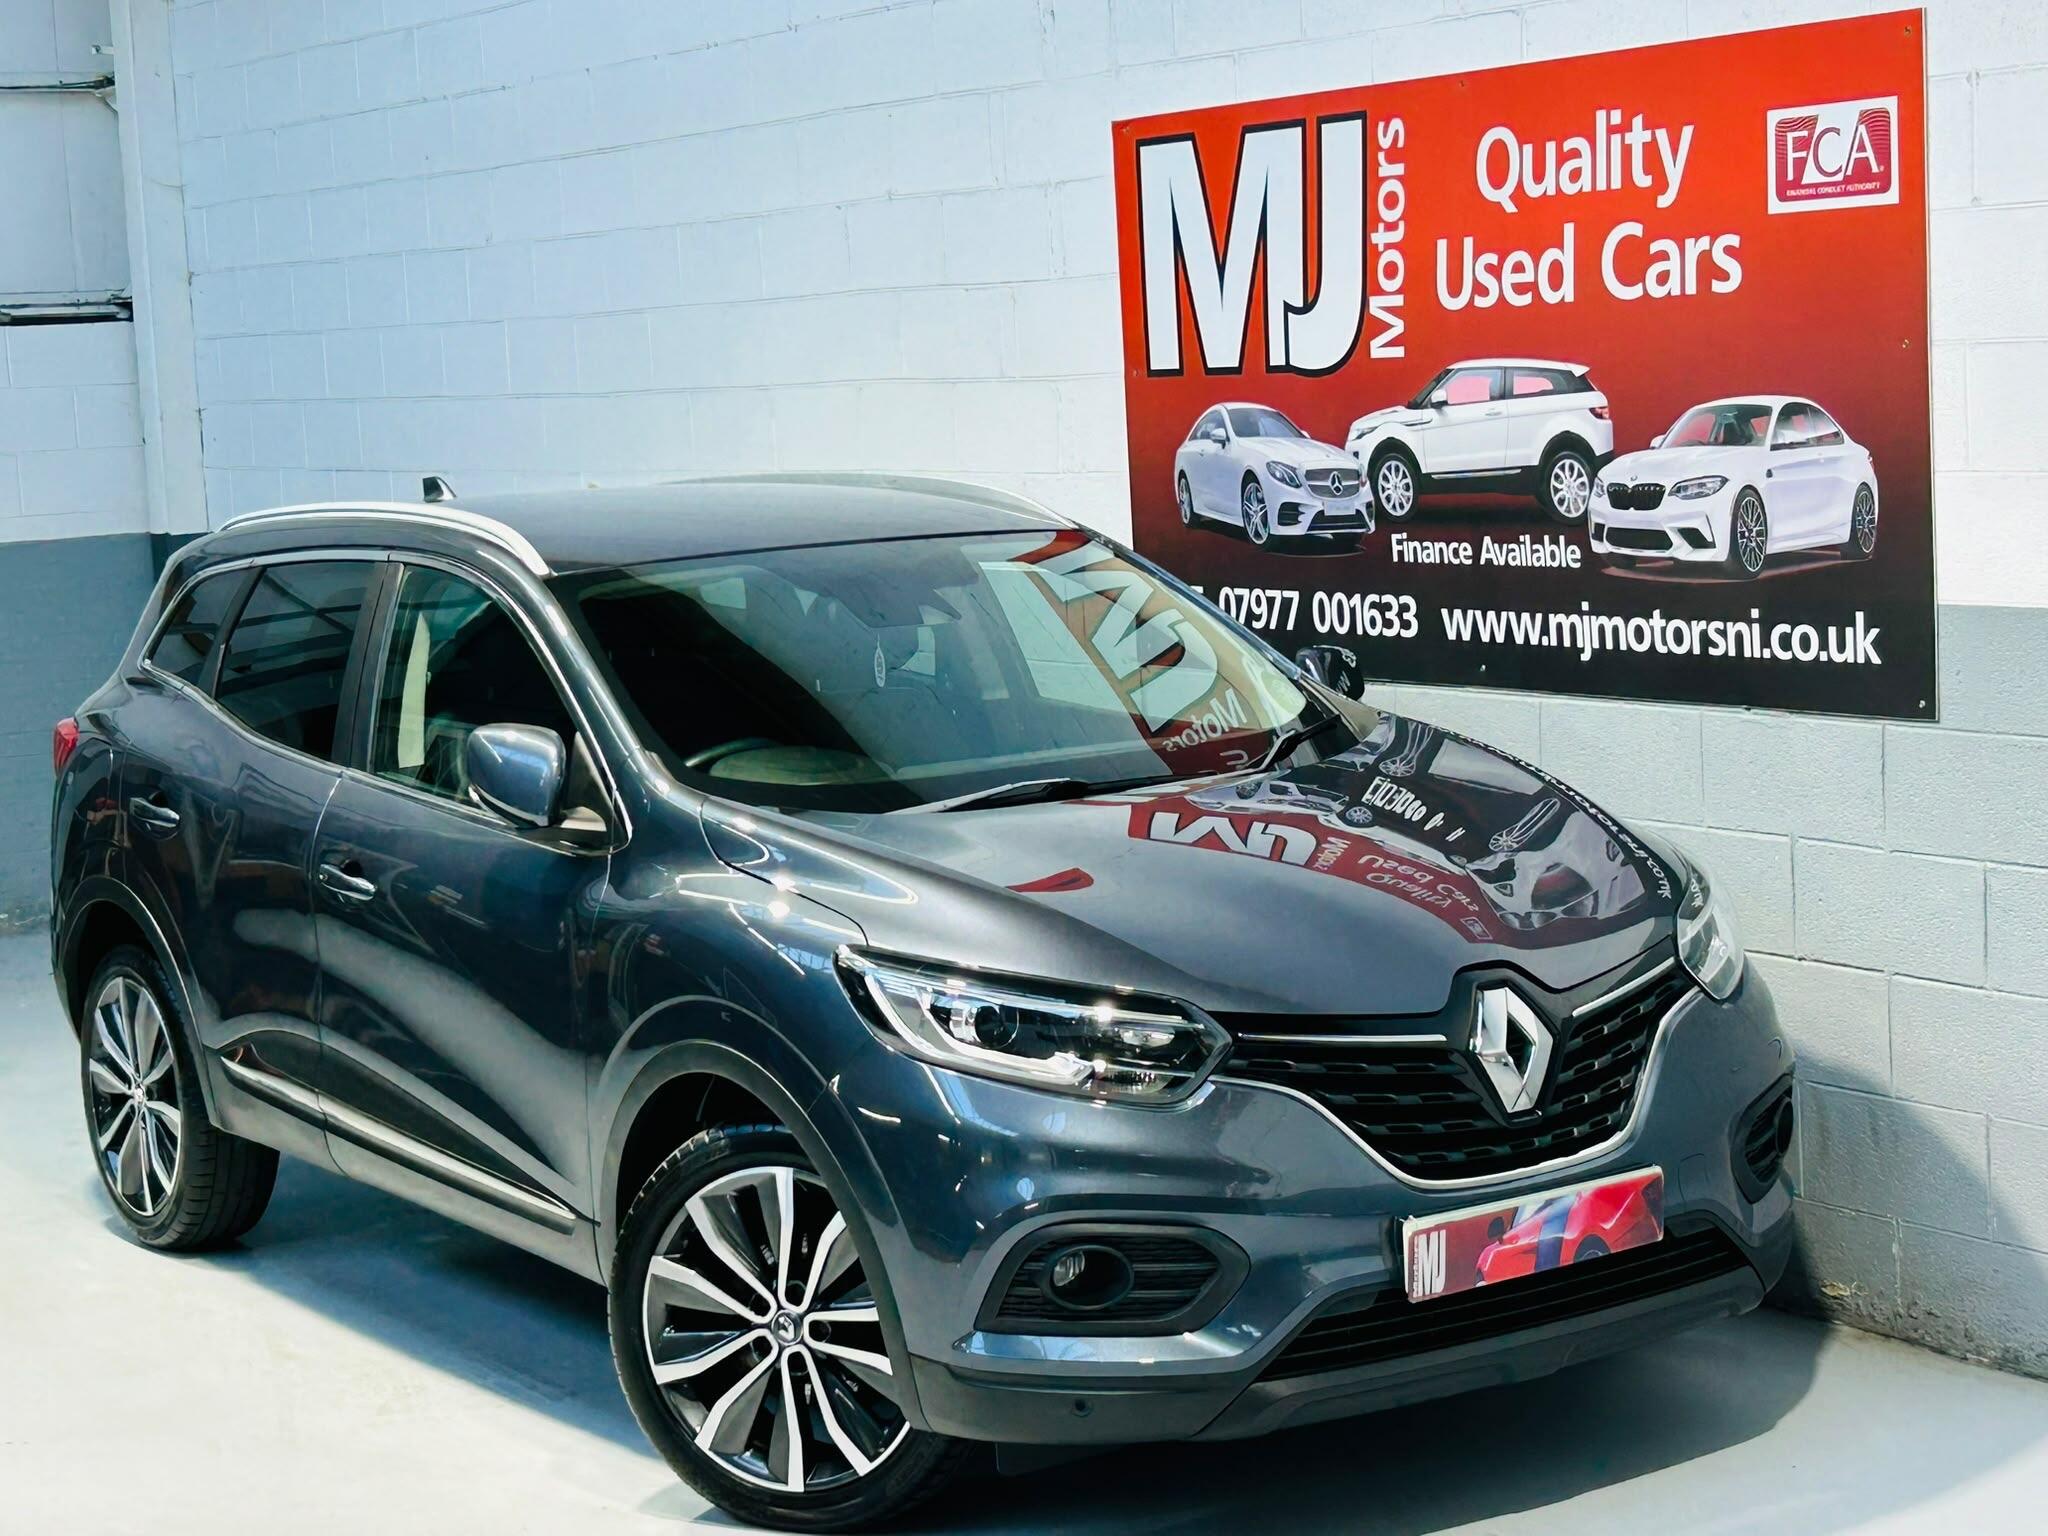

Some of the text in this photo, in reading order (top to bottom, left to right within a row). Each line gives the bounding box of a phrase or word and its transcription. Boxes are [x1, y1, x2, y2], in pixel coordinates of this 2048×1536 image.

[1476, 108, 1695, 213] Quality
[1786, 124, 1880, 181] FCA
[1137, 110, 1367, 377] MJ
[1370, 117, 1406, 359] Motors
[1436, 222, 1743, 310] Used Cars
[1390, 533, 1582, 568] Finance Available
[1218, 586, 1419, 638] 07977 001633
[1441, 601, 1882, 664] www.mjmotorsni.co.uk
[1419, 1230, 1446, 1296] MJ
